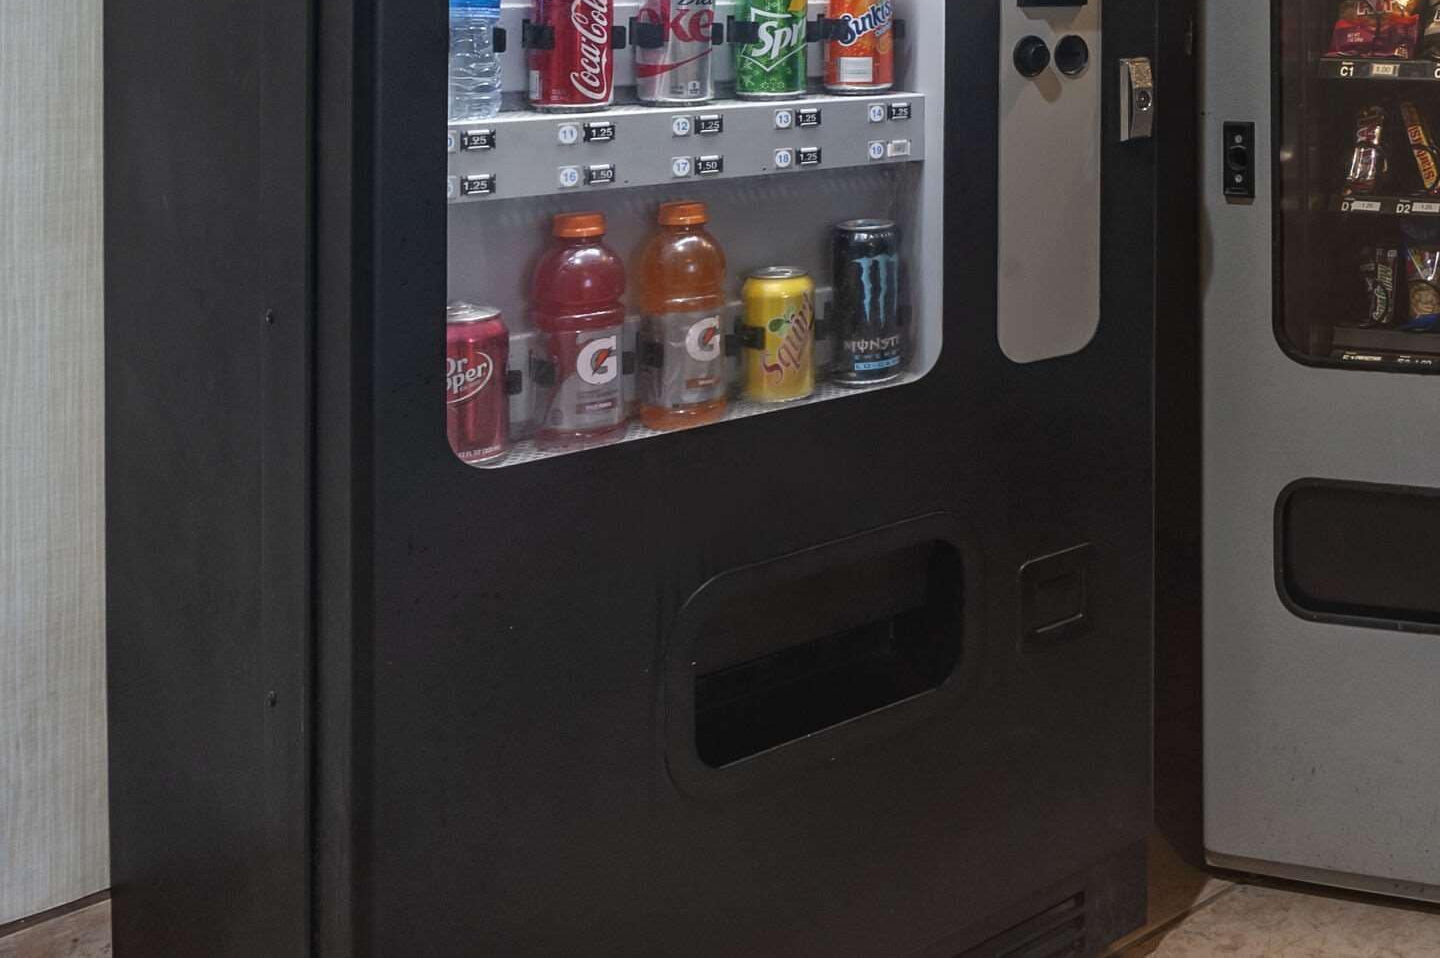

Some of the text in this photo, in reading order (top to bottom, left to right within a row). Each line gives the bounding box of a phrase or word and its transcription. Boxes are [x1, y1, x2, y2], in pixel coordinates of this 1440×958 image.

[1340, 66, 1354, 76] C1
[872, 109, 882, 117] 14
[891, 108, 908, 116] 1.25
[778, 115, 790, 124] 13
[799, 114, 817, 122] 1.25
[676, 121, 688, 131] 12
[701, 121, 720, 130] 1.25
[562, 129, 574, 139] 11
[591, 128, 613, 137] 1.25
[872, 145, 882, 154] 19
[778, 154, 789, 163] 18
[799, 153, 817, 161] 1.25
[676, 162, 688, 172] 17
[697, 161, 718, 171] 1.50
[563, 171, 577, 182] 16
[591, 169, 613, 179] 1.50
[463, 181, 488, 191] 1.25
[1396, 203, 1411, 214] D2
[576, 334, 617, 385] G
